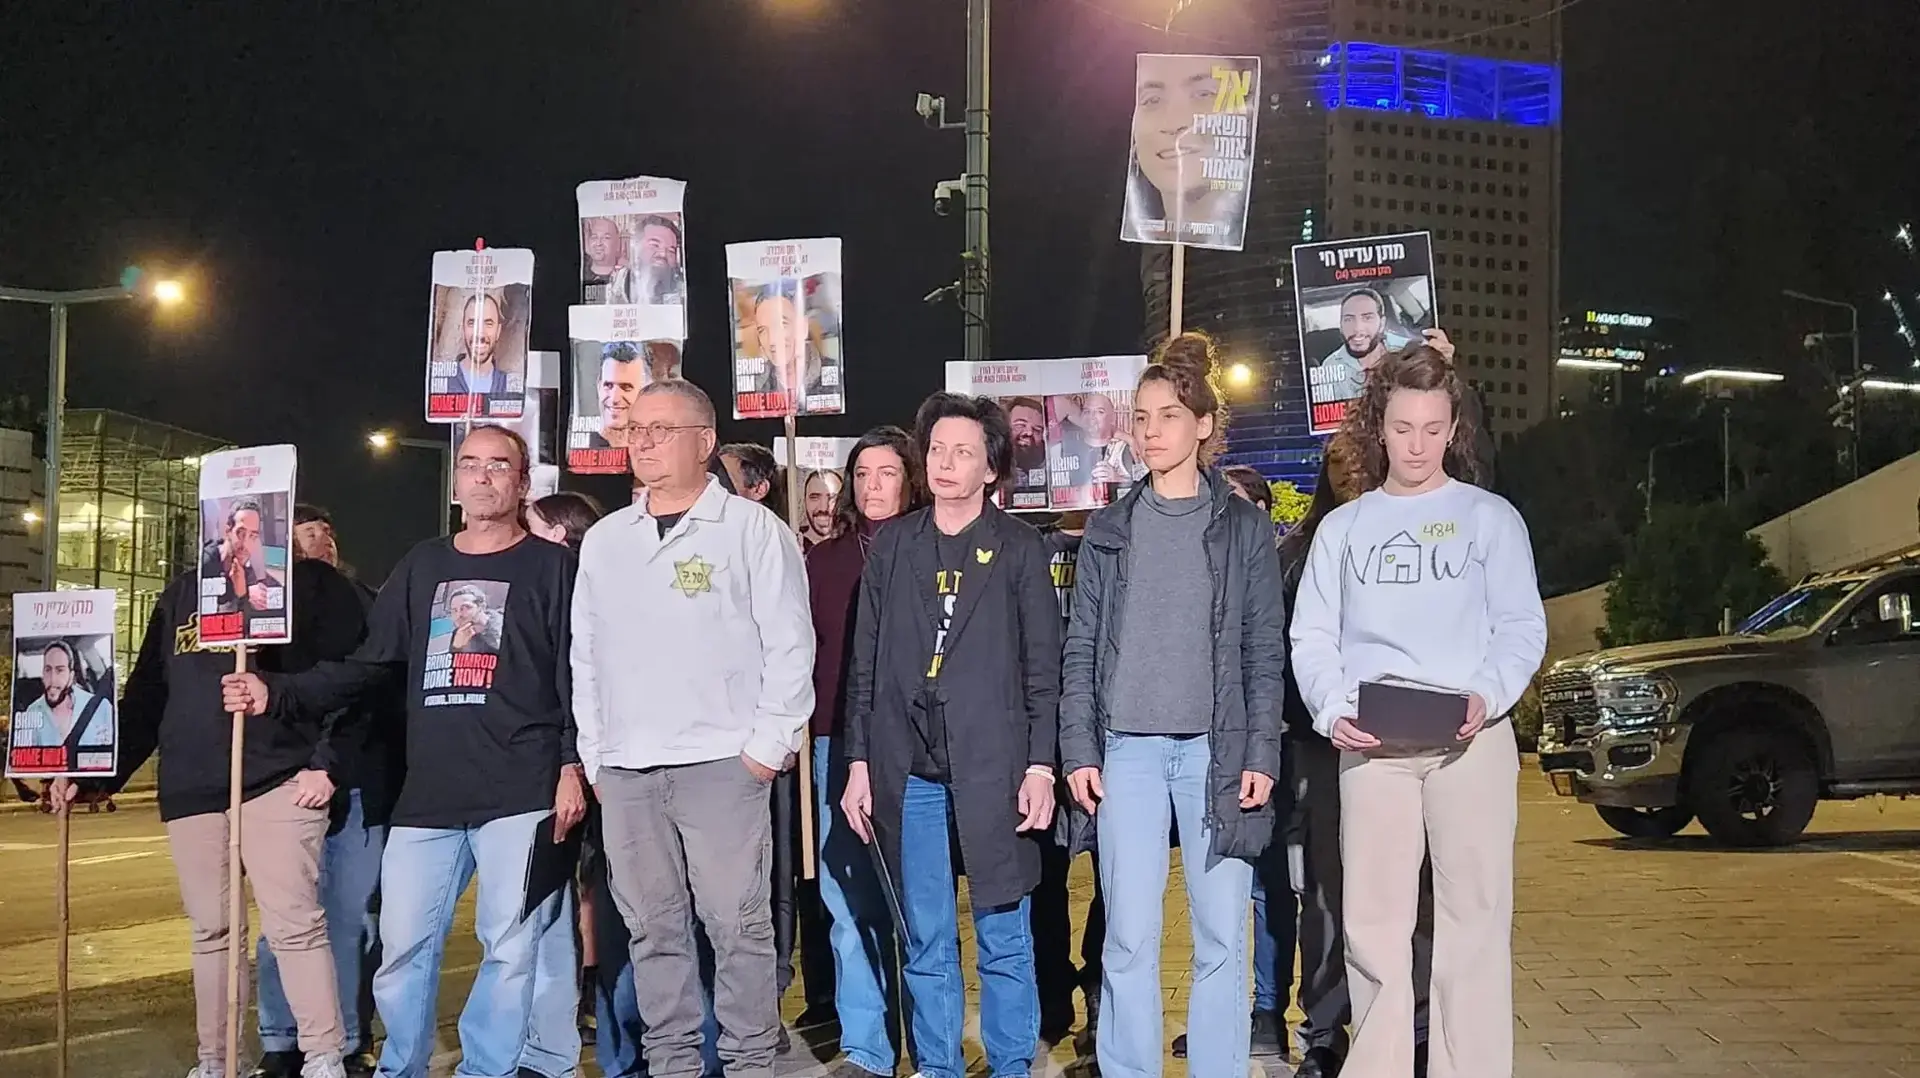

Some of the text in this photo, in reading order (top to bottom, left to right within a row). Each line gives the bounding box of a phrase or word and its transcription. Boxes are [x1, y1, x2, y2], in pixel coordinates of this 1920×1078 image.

[1211, 66, 1251, 113] אל
[1214, 136, 1246, 159] אותי
[1200, 157, 1245, 179] מאחור
[1318, 243, 1405, 269] מתן עדיין חי
[1620, 313, 1653, 328] GROUP
[432, 361, 458, 377] BRING
[736, 358, 764, 375] BRING
[1310, 363, 1346, 385] BRING
[431, 377, 448, 393] HIM
[736, 375, 755, 392] HIM
[1311, 382, 1335, 404] HIM
[430, 394, 455, 411] HOME
[737, 393, 765, 412] HOME
[1313, 402, 1348, 424] HOME
[572, 415, 601, 432] BRING
[570, 432, 590, 448] HIM
[569, 447, 628, 466] HOME NOW!
[1051, 456, 1080, 471] BRING
[1051, 471, 1071, 486] HIM
[1423, 522, 1455, 537] 484
[682, 570, 704, 584] 7.10
[71, 600, 93, 617] מתן
[426, 653, 497, 671] BRING NIMROD
[423, 668, 493, 690] HOME NOW!
